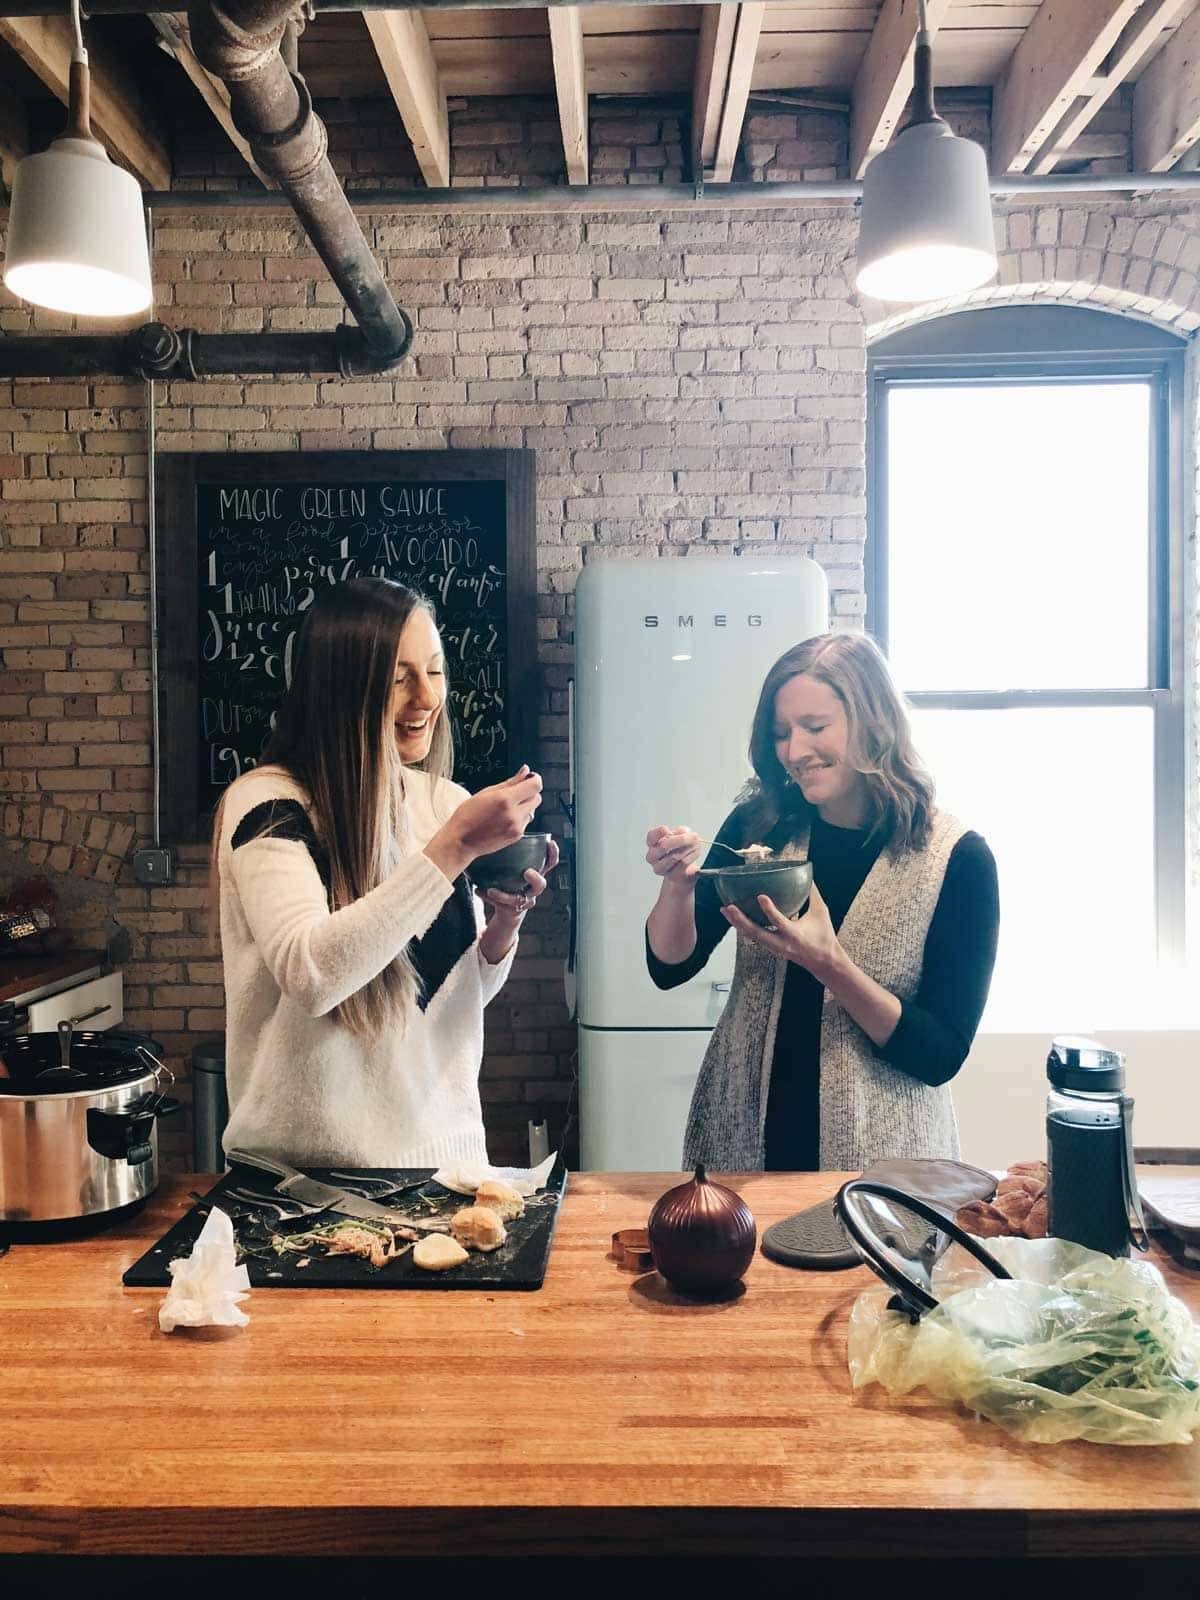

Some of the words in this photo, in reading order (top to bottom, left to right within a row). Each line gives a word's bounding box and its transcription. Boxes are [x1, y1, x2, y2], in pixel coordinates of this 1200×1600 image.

[219, 487, 284, 521] MAGIC
[301, 487, 365, 520] GREEN
[379, 486, 448, 518] SAUCE
[208, 550, 218, 586] 1
[375, 533, 478, 571] AVOCADO
[644, 615, 762, 628] SMEG
